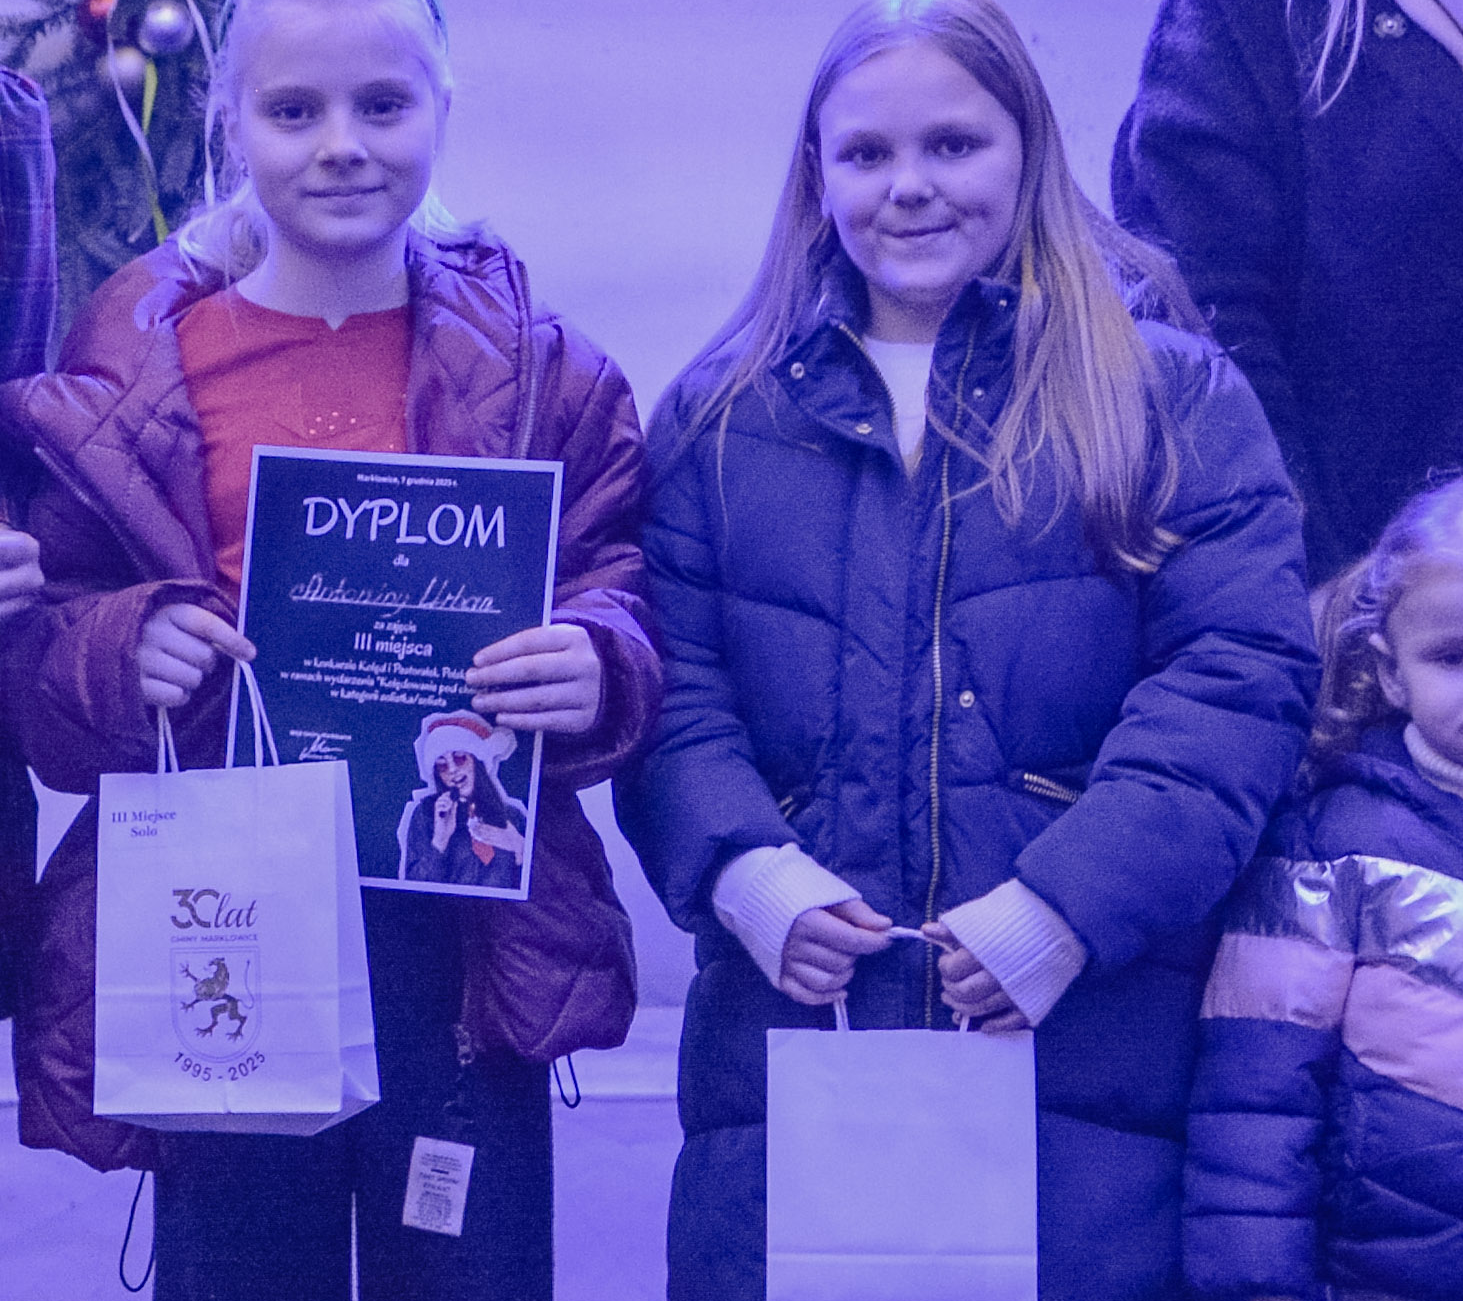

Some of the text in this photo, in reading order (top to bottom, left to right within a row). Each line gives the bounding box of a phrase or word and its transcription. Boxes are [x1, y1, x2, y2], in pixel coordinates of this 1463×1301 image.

[302, 496, 506, 548] DYPLOM
[393, 554, 410, 567] dla
[354, 632, 433, 660] III miejsca
[111, 808, 178, 825] III Miejsce
[130, 824, 158, 838] Solo
[214, 892, 259, 929] lat
[174, 1051, 212, 1082] 1995
[228, 1050, 265, 1082] 2025
